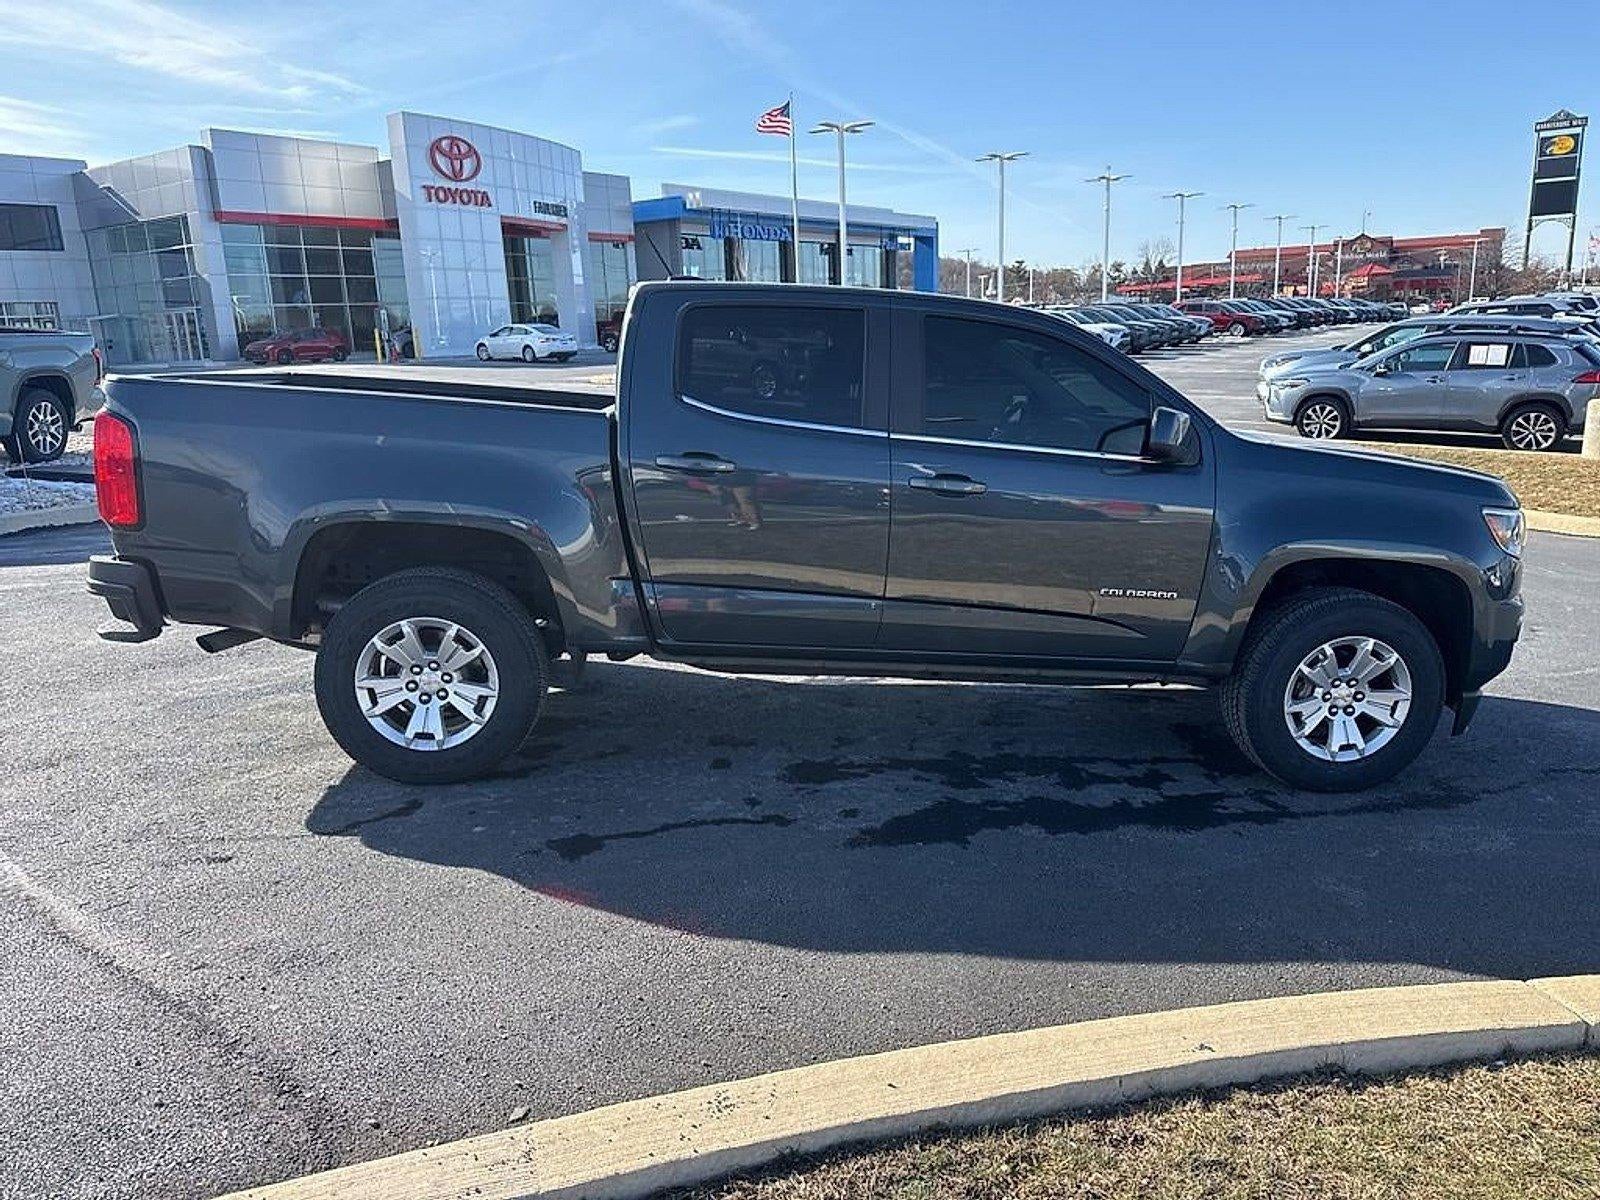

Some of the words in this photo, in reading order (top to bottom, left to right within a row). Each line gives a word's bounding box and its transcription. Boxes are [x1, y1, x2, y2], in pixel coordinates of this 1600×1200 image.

[422, 185, 492, 207] TOYOTA
[724, 223, 792, 241] HONDA
[1099, 588, 1178, 599] COLORADO
